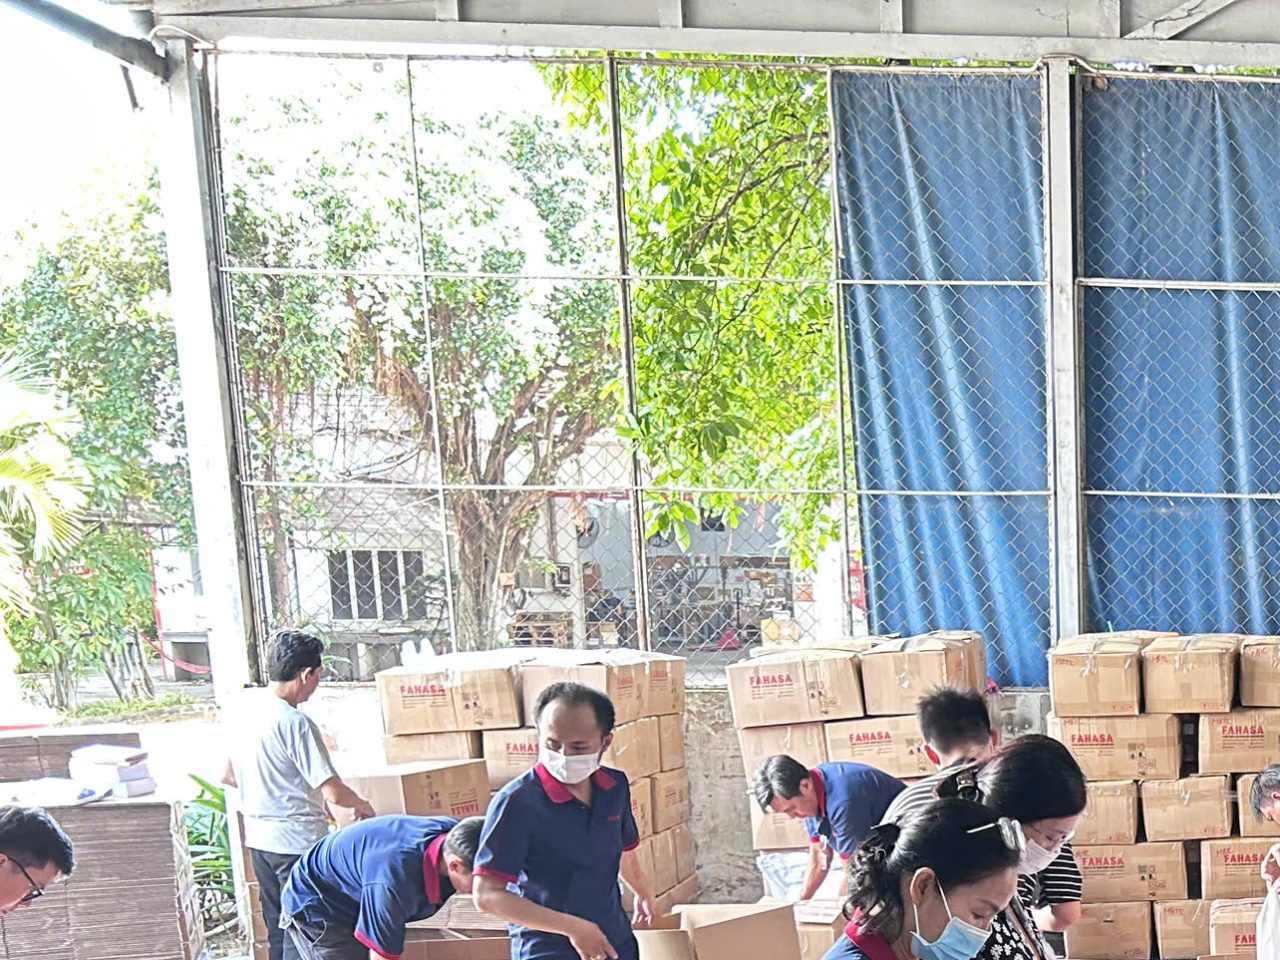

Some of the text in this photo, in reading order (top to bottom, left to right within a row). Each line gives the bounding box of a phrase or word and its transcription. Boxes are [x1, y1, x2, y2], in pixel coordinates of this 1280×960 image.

[750, 674, 793, 686] FAHASA
[1221, 725, 1264, 736] FAHASA
[849, 731, 892, 744] FAHASA
[1071, 734, 1114, 745] FAHASA
[506, 743, 539, 753] FAHAS
[1081, 857, 1125, 867] FAHASA
